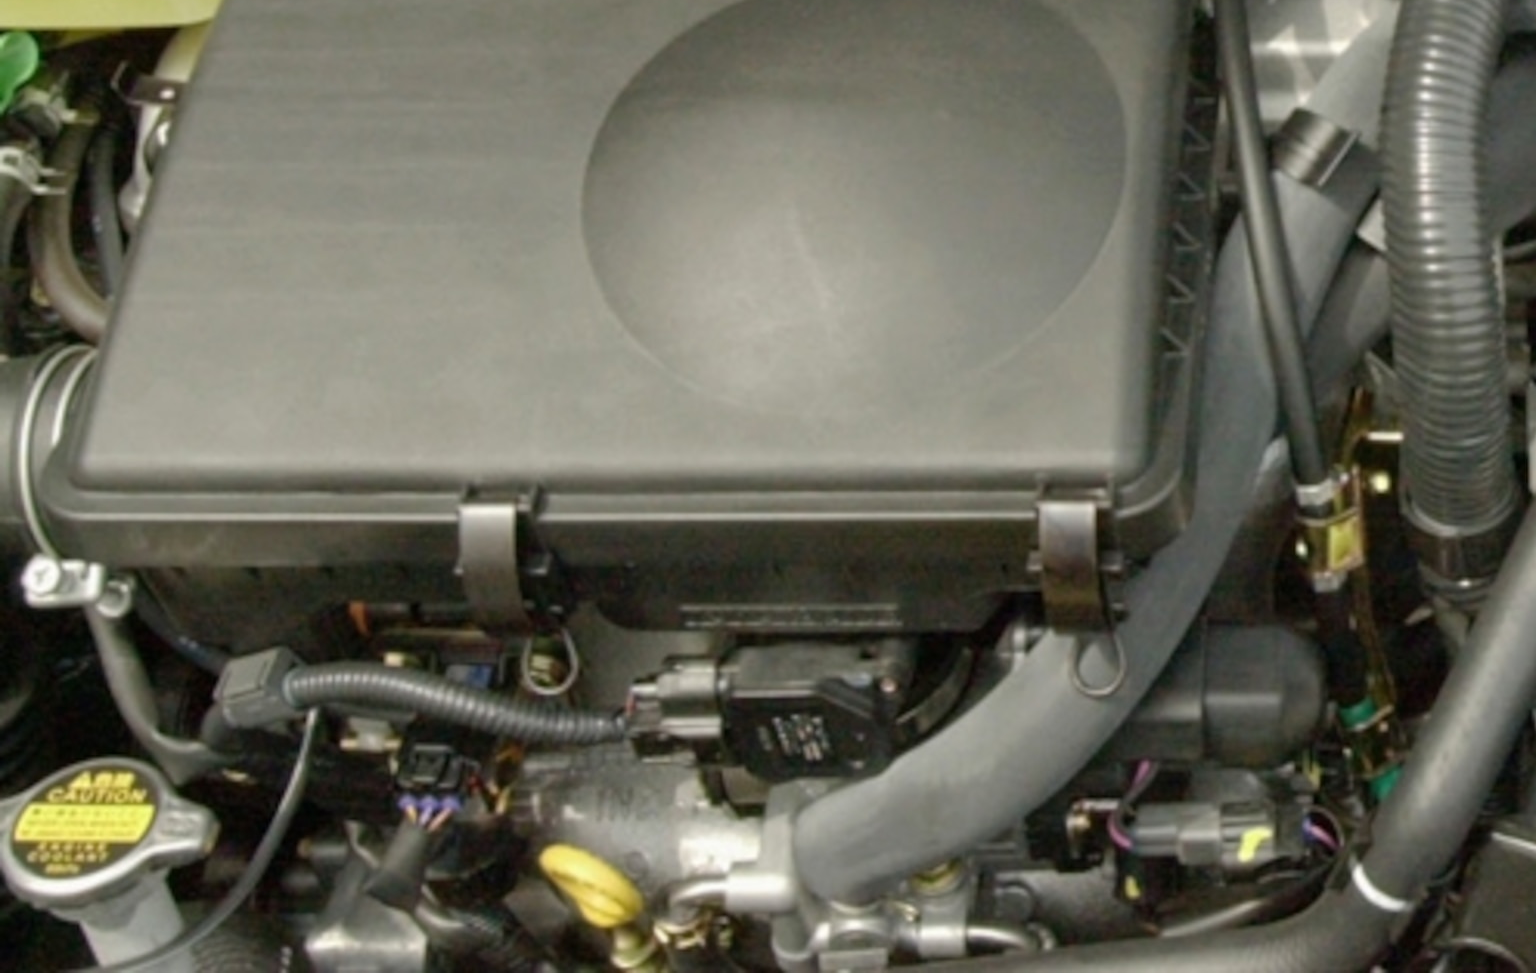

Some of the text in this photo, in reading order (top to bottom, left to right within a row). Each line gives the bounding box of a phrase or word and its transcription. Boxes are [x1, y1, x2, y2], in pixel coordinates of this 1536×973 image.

[47, 788, 147, 803] CAUTION
[36, 842, 107, 852] ENGINE
[26, 852, 109, 863] COOLANT
